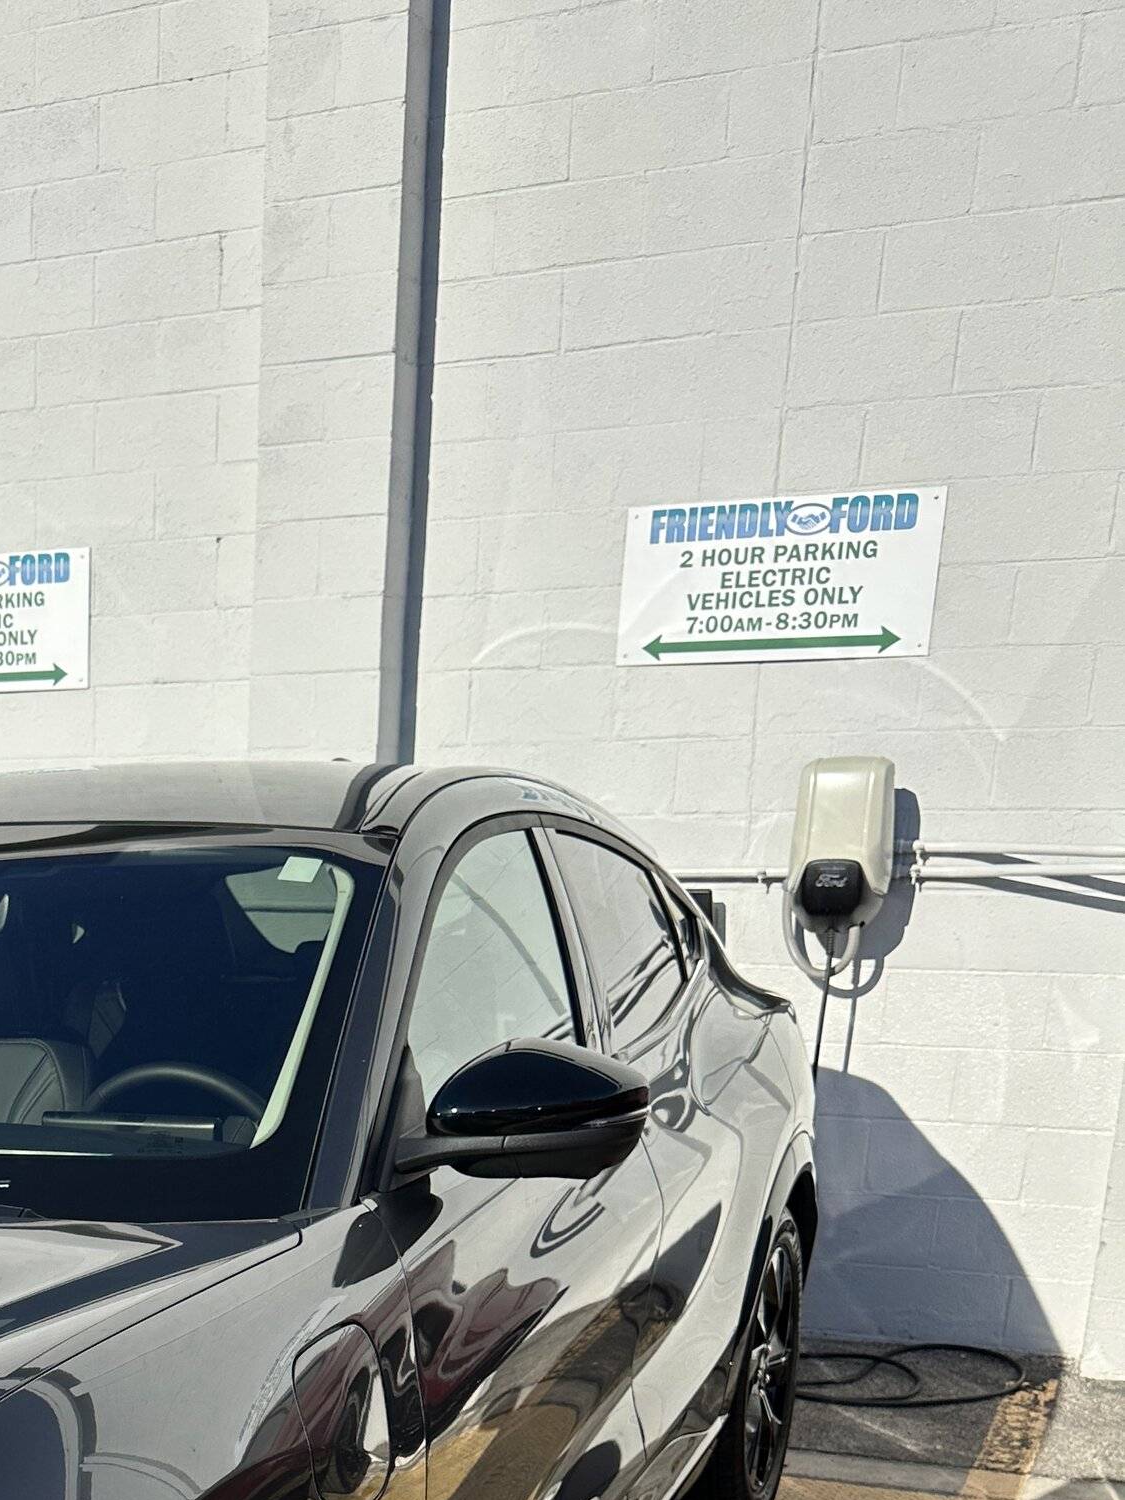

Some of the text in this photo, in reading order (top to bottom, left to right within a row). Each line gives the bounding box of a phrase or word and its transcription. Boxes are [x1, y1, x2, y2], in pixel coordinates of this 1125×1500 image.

[649, 492, 920, 545] FRIENDLY FORD
[679, 540, 879, 568] 2 HOUR PARKING
[8, 552, 70, 586] FORD
[720, 566, 831, 589] ELECTRIC
[686, 585, 864, 611] VEHICLES ONLY
[686, 611, 859, 635] 7:00AM-8:30PM
[816, 873, 848, 888] Ford
